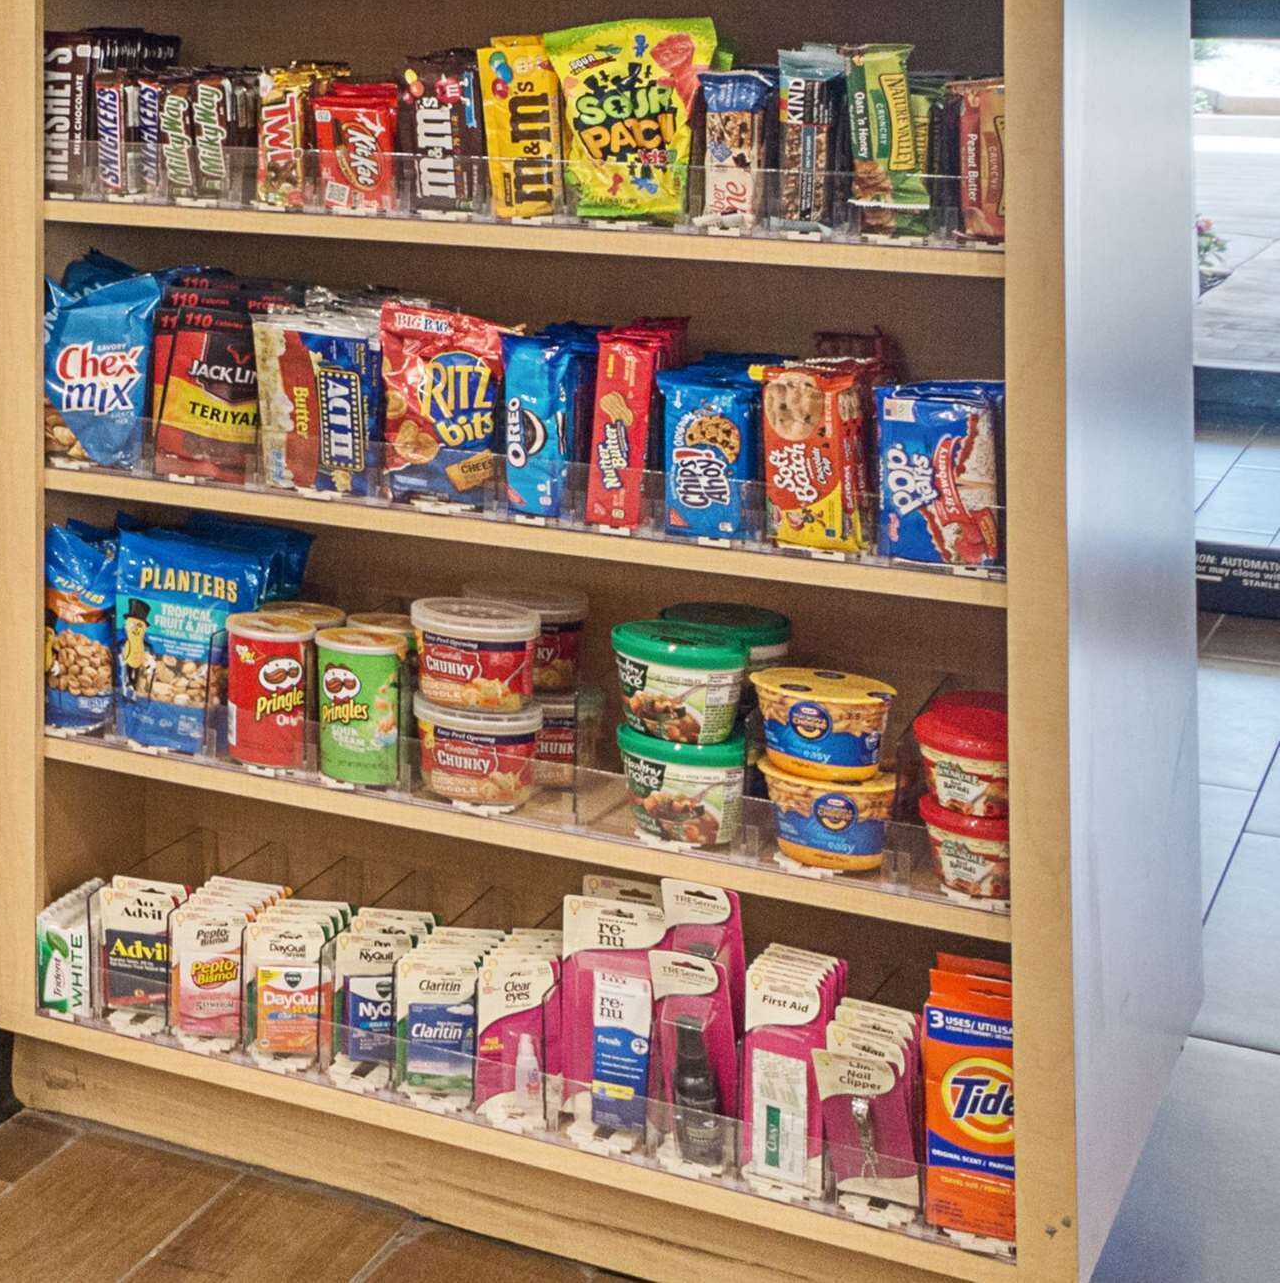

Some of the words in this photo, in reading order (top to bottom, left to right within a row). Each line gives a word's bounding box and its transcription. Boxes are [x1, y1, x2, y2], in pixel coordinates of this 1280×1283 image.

[73, 74, 84, 131] CHOCOLATE
[577, 86, 673, 125] SOUR
[787, 78, 805, 124] KIND
[854, 91, 865, 115] Oats
[885, 77, 910, 124] NATURE
[876, 103, 887, 145] CRUNCHY
[97, 87, 122, 187] SNICKERS
[858, 128, 869, 158] Honey
[896, 124, 914, 167] VALLEY
[968, 133, 978, 167] Peanut
[968, 171, 978, 201] Butter
[171, 292, 199, 307] 110
[186, 313, 214, 328] 110
[395, 314, 423, 328] BIG
[58, 345, 139, 379] Chex
[189, 359, 232, 384] JACK
[65, 378, 135, 413] mix
[422, 363, 493, 419] RITZ
[190, 401, 259, 426] TERIYA
[293, 386, 309, 439] Butter
[436, 411, 494, 446] bits
[507, 397, 527, 467] OREO
[606, 424, 628, 469] Butter
[598, 444, 621, 489] Nutter
[769, 446, 796, 492] Soft
[792, 443, 817, 502] Batch
[678, 459, 710, 507] Chips
[1209, 567, 1230, 576] may
[1233, 569, 1260, 578] close
[1242, 579, 1280, 589] STANLE
[140, 567, 238, 603] PLANTERS
[155, 615, 183, 630] FRUIT
[186, 619, 196, 631] &
[198, 623, 217, 633] NUT
[161, 605, 211, 621] TROPICAL
[450, 639, 478, 649] Opening
[426, 655, 474, 680] CHUNKY
[256, 689, 305, 721] Pringle
[322, 699, 368, 723] Pringles
[466, 734, 495, 743] Opening
[437, 750, 490, 773] CHUNKY
[803, 749, 831, 764] easy
[828, 841, 855, 853] easy
[121, 907, 162, 921] Advil
[196, 928, 230, 940] Pepto-
[200, 936, 229, 947] Bismol
[598, 935, 625, 948] nu
[110, 938, 167, 961] Advil
[269, 943, 306, 953] DayQuil
[359, 951, 393, 962] NyQuil
[52, 956, 63, 997] Trident
[71, 933, 83, 1008] WHITE
[192, 961, 239, 973] Pepto-
[197, 968, 238, 984] Bismol
[419, 980, 461, 993] Claritin
[505, 981, 531, 992] Clear
[505, 992, 530, 1003] eyes
[263, 991, 324, 1008] DayQuil
[762, 994, 787, 1008] First
[788, 1000, 810, 1013] Aid
[600, 1007, 623, 1020] nu
[929, 1010, 944, 1029] 3
[411, 1024, 462, 1040] Claritin
[597, 1035, 621, 1046] fresh
[839, 1076, 881, 1090] Clipper
[847, 1070, 871, 1080] Nail
